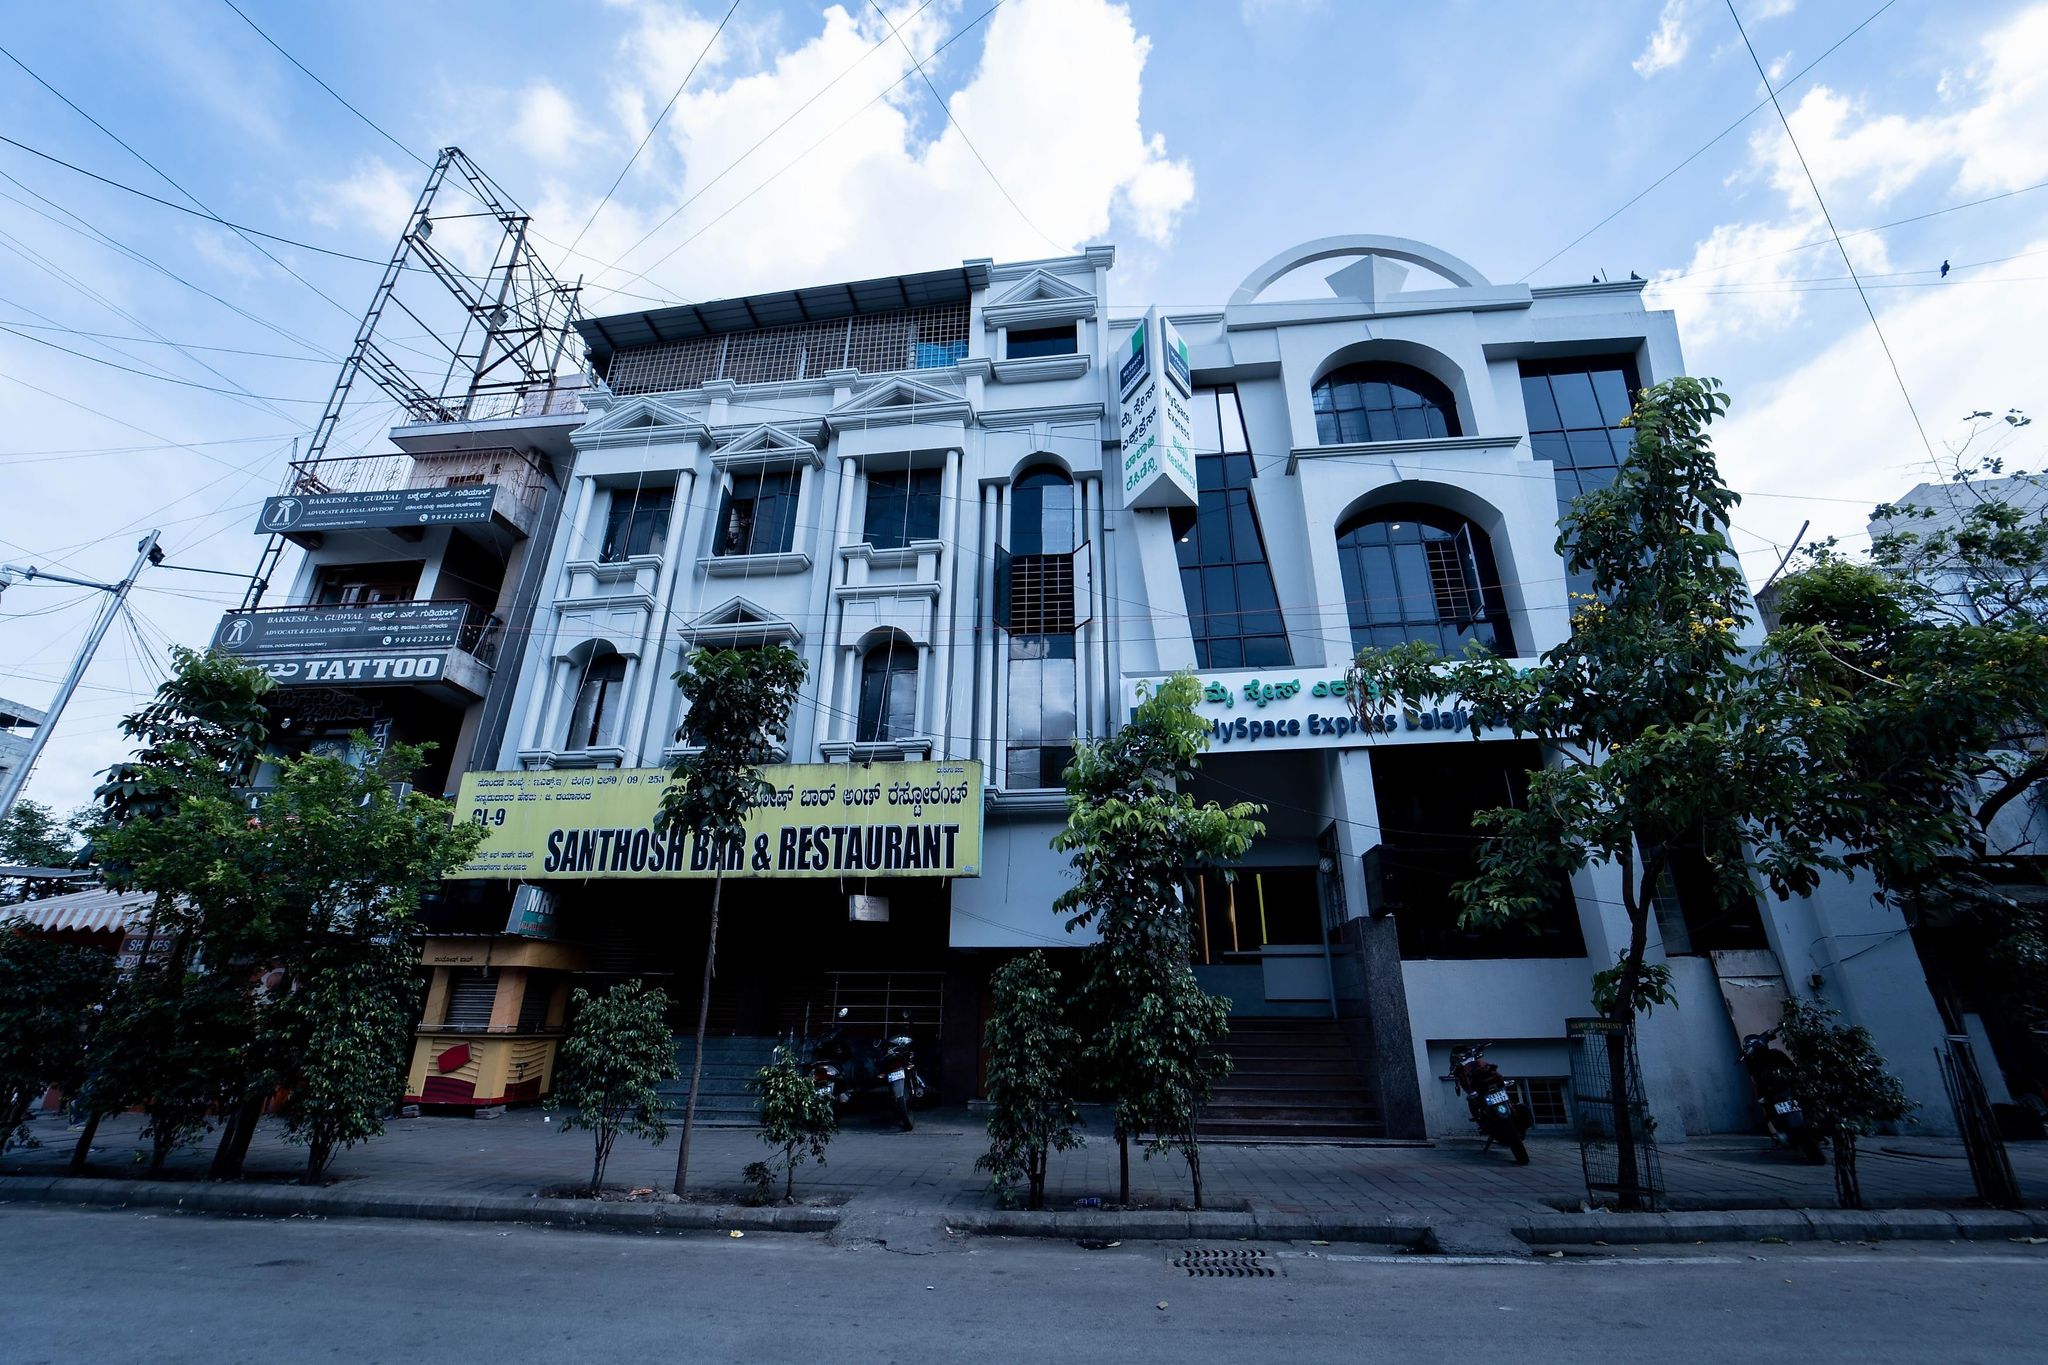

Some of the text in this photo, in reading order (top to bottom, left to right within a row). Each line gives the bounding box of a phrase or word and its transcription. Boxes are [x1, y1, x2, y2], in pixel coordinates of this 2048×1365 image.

[1164, 387, 1190, 424] MySpace
[1168, 408, 1190, 441] Express
[1167, 448, 1196, 490] Residency
[308, 496, 348, 505] BAKKESH
[363, 493, 401, 502] GUDIYAL
[306, 508, 338, 516] ADVOCATE
[266, 615, 308, 624] BAKKESH
[324, 613, 364, 622] GUDIYAL
[394, 635, 452, 643] 9844222616
[304, 657, 440, 681] TATTOO
[1203, 716, 1300, 744] MySpace
[800, 783, 836, 807] ಬಾರ್
[843, 782, 881, 807] ಅಂಡ್
[472, 808, 507, 827] CL-9
[544, 823, 960, 873] SANTHOSH BAR & RESTAURANT
